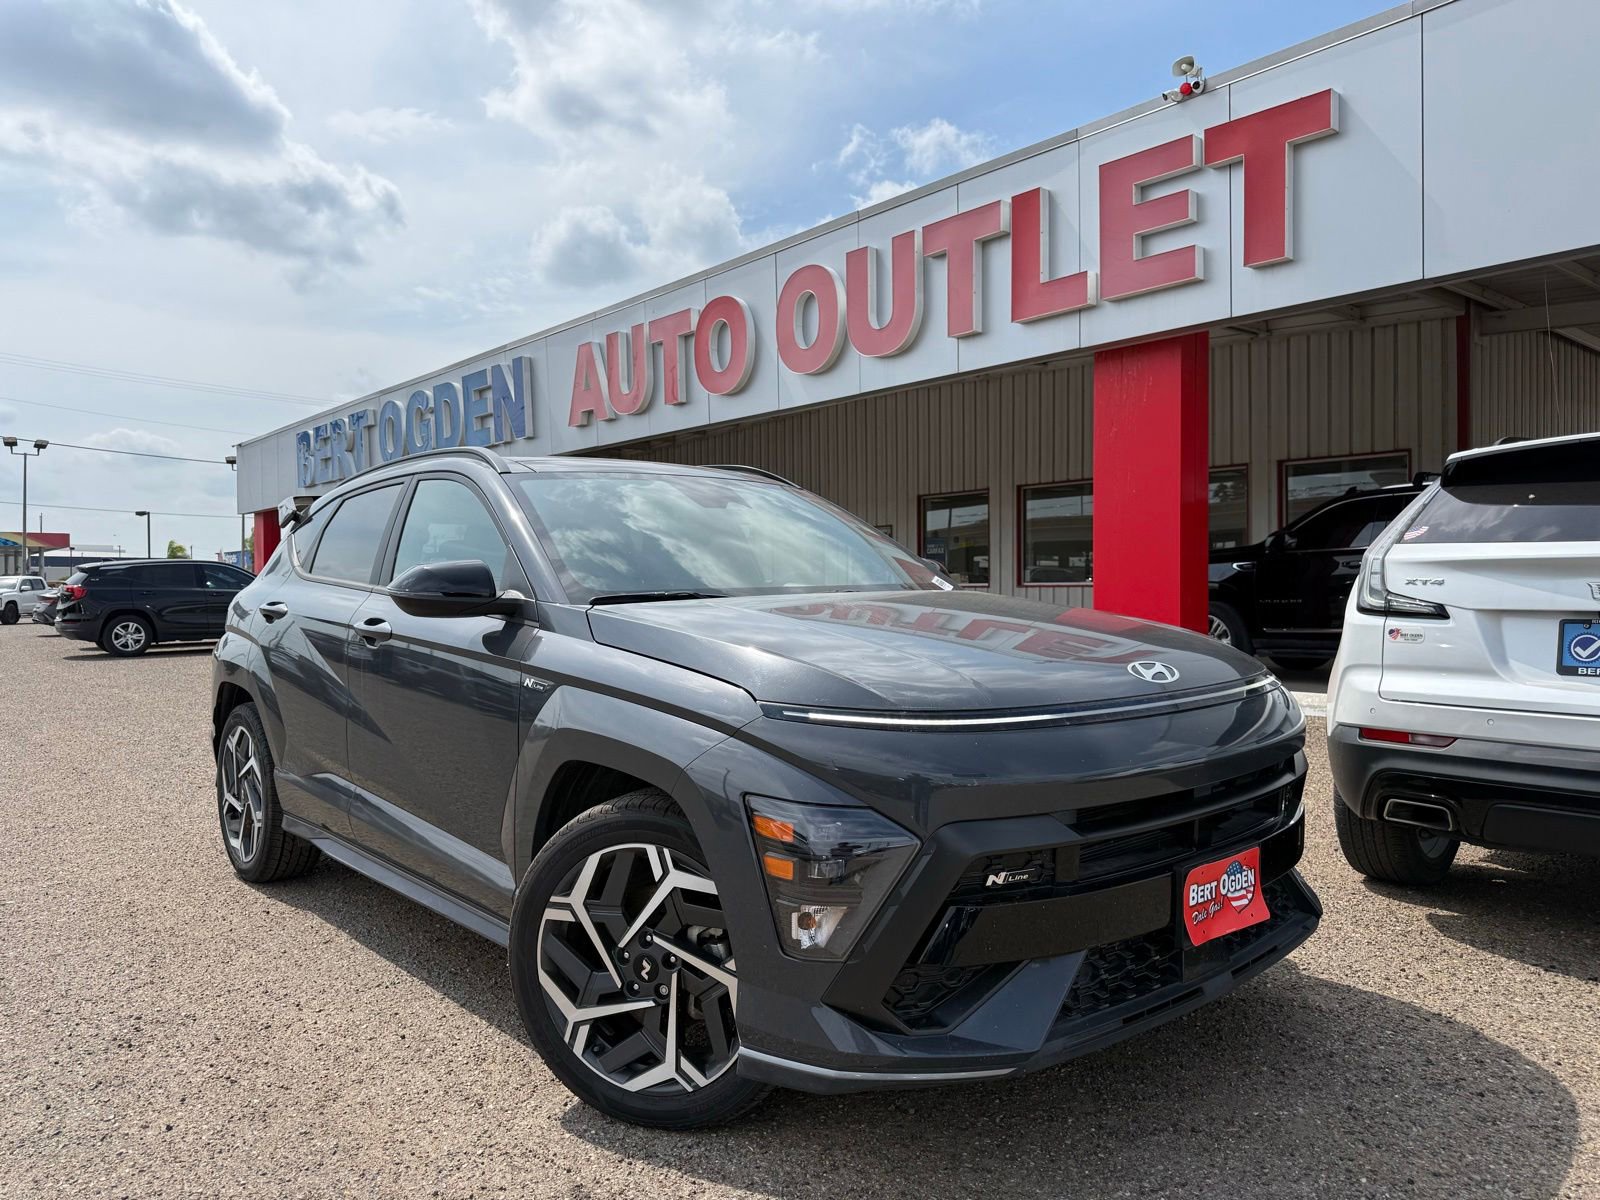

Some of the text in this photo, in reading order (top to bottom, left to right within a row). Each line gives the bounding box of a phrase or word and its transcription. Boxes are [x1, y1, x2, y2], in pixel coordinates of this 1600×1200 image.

[296, 88, 1340, 488] BERT OGDEN AUTO OUTLET
[1405, 578, 1445, 586] XT4
[1189, 869, 1255, 907] BERT OGDEN
